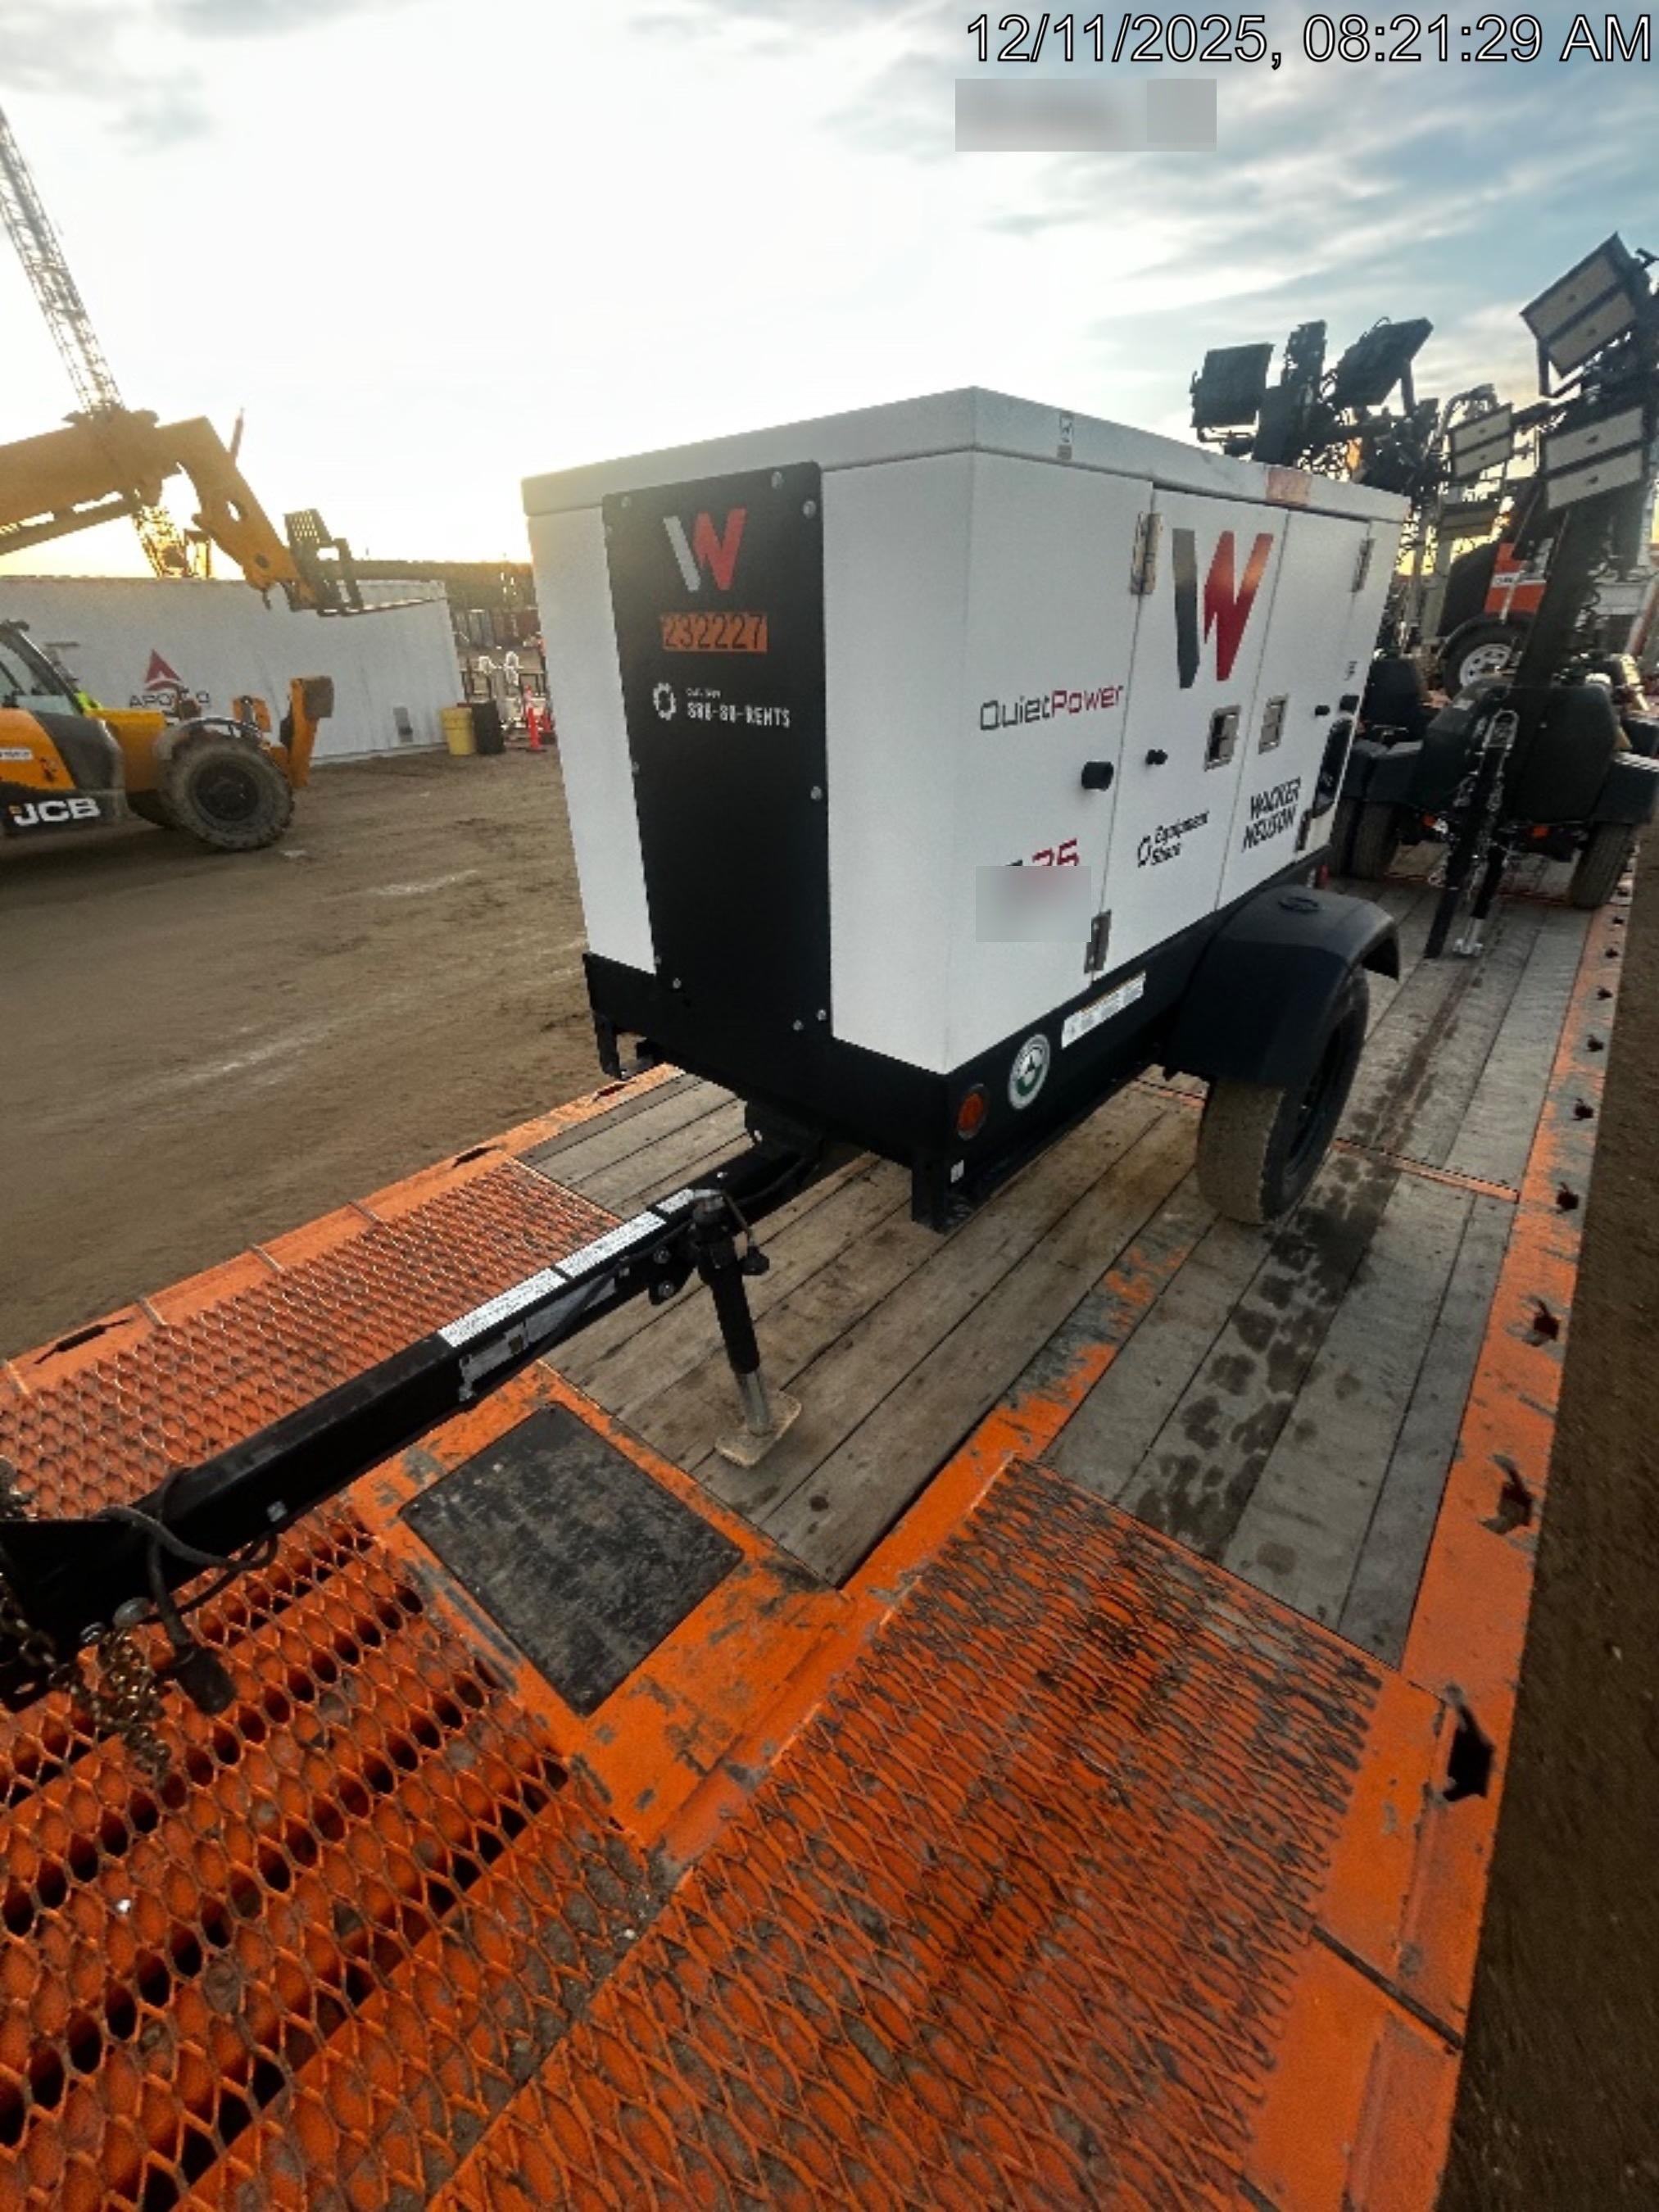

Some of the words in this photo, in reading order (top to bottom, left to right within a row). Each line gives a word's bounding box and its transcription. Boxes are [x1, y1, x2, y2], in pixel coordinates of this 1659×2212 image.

[664, 614, 764, 649] 232227
[981, 686, 1123, 730] QuietPower
[13, 797, 101, 827] JCB
